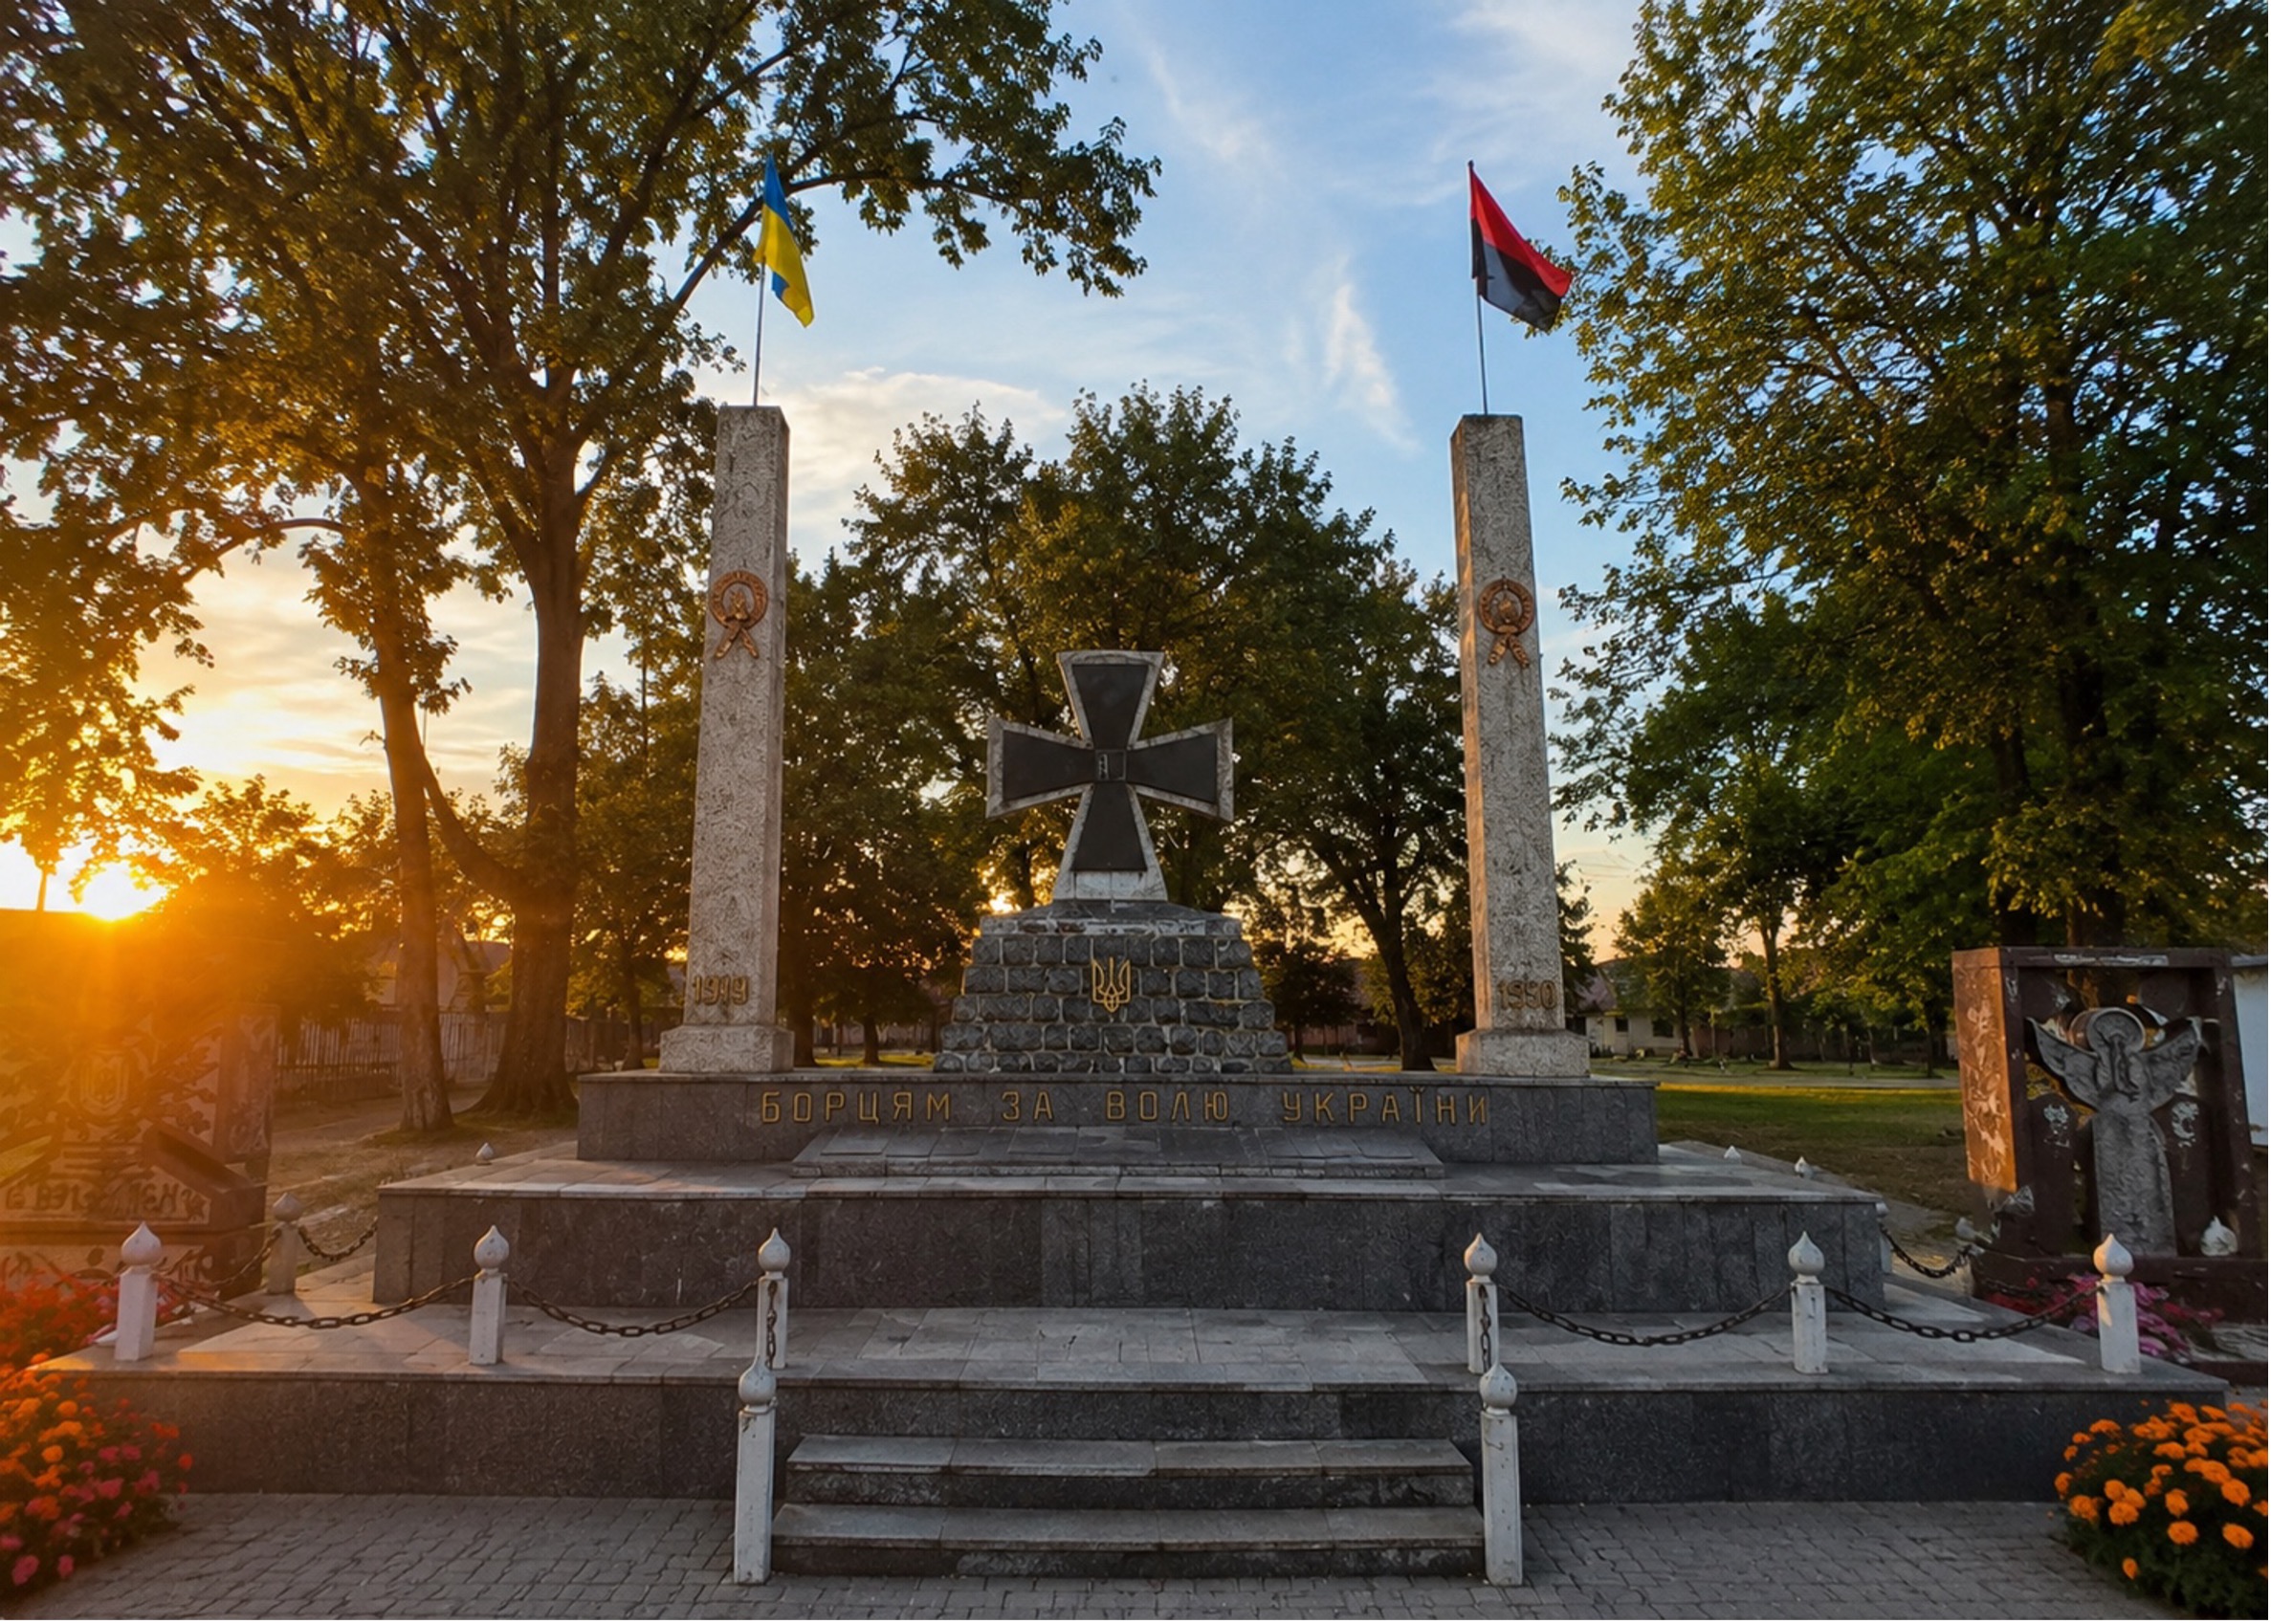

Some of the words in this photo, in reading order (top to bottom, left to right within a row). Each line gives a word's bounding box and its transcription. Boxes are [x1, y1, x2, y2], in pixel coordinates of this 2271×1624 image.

[692, 975, 749, 1005] 1919
[1498, 979, 1558, 1010] 1950
[761, 1090, 952, 1125] БОРЦЯМ
[1002, 1090, 1054, 1122] ЗА
[1106, 1090, 1230, 1122] ВОЛЮ
[1281, 1086, 1488, 1126] УКРАЇНИ
